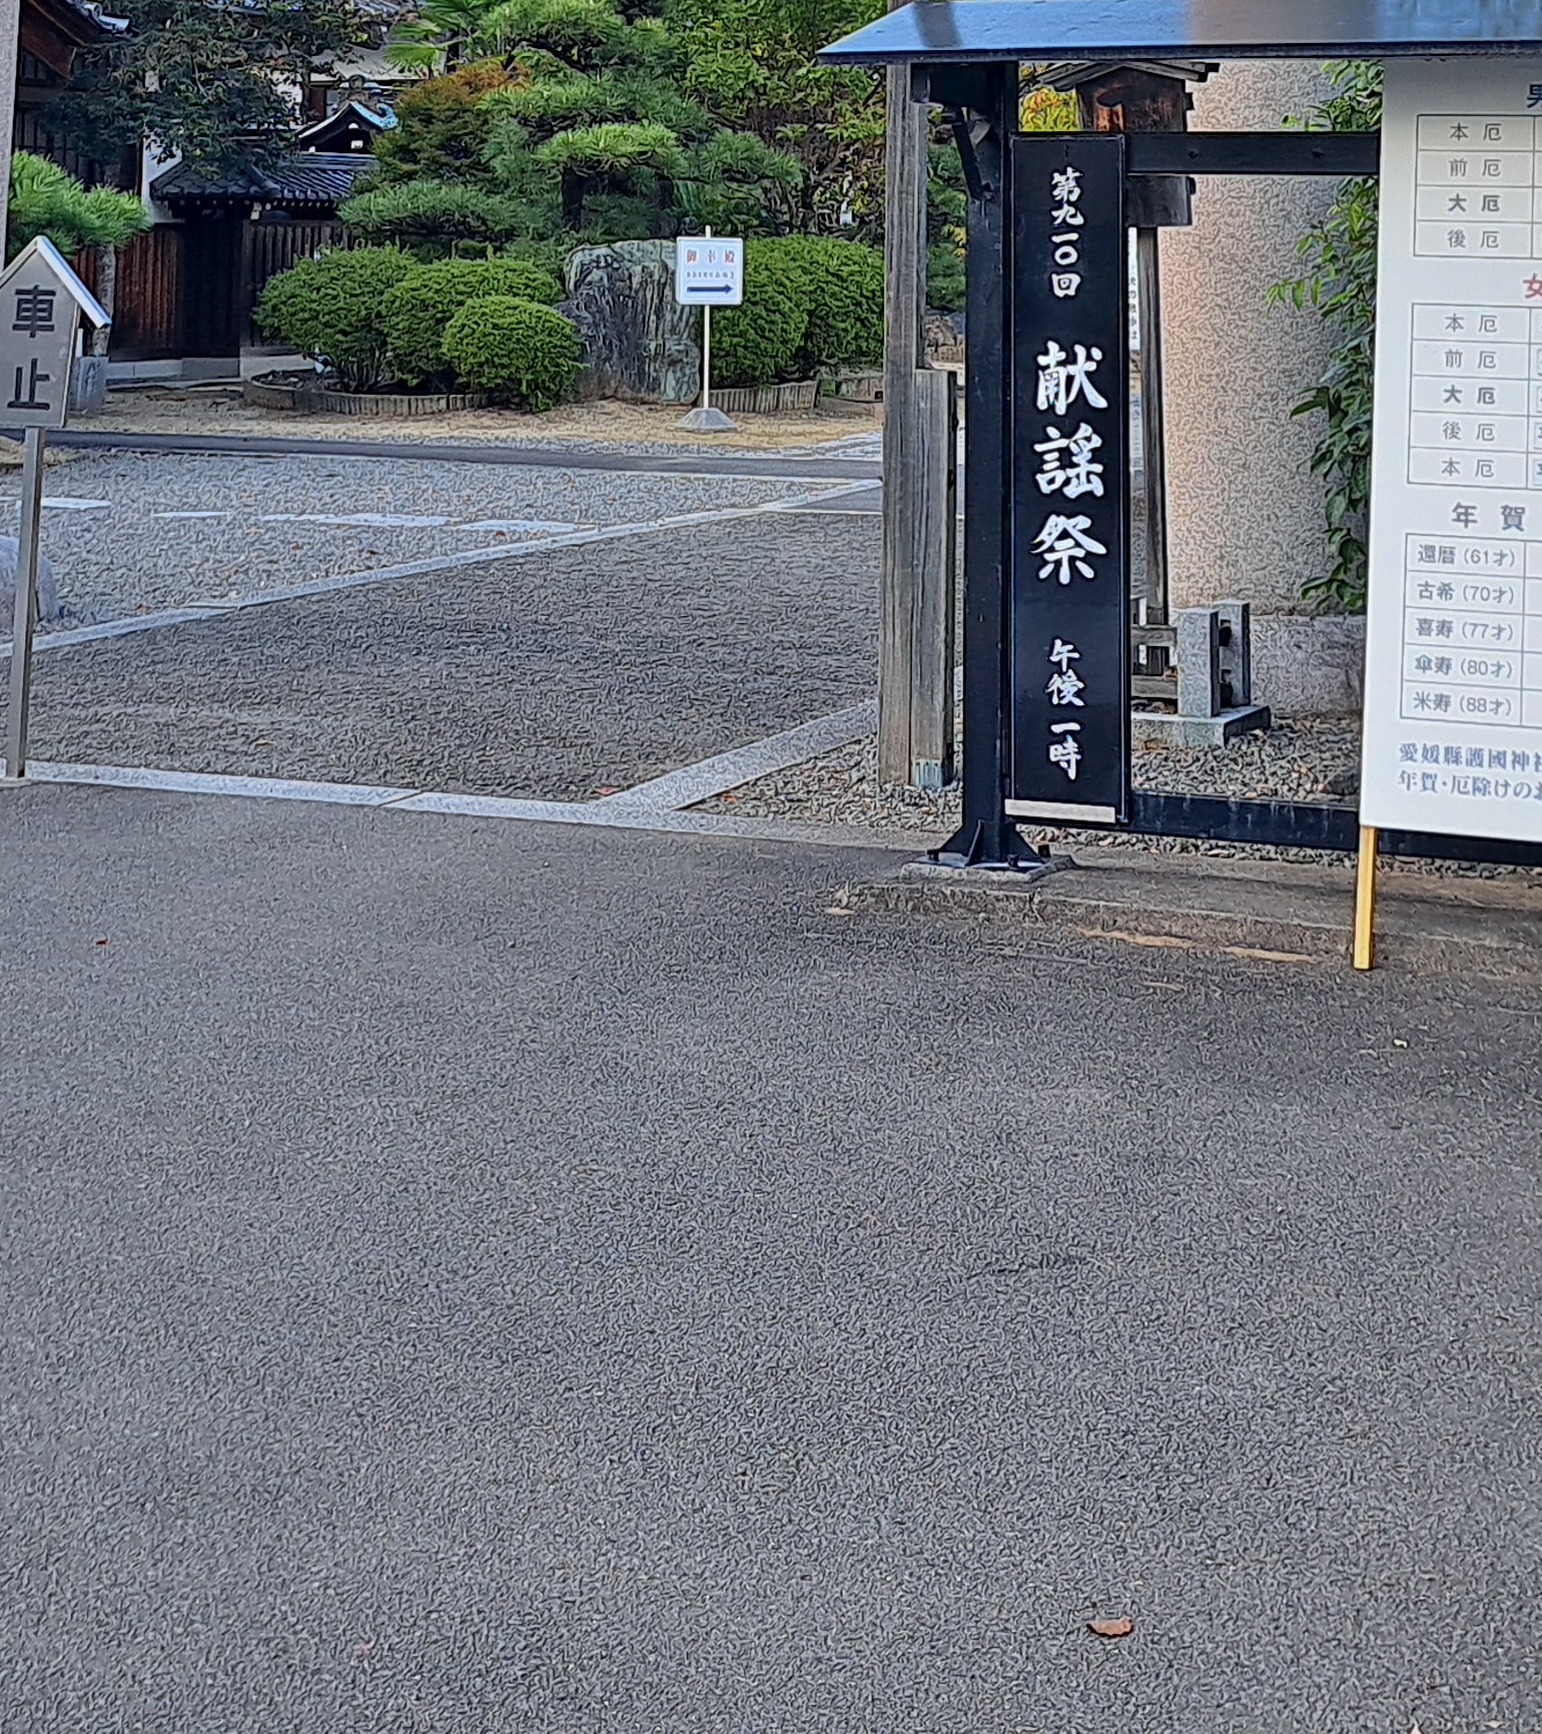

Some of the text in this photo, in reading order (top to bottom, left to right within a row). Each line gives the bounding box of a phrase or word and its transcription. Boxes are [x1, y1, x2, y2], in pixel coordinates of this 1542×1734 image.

[1449, 122, 1503, 142] 本厄
[1448, 158, 1502, 178] 前厄
[1447, 194, 1501, 214] 大厄
[1444, 313, 1498, 334] 本厄
[6, 284, 57, 411] 車止
[1444, 348, 1498, 369] 前厄
[1442, 385, 1496, 405] 大厄
[1029, 165, 1109, 781] 第九一〇回 献謡祭 午後一時
[1440, 457, 1495, 478] 本厄
[1451, 501, 1527, 532] 年賀
